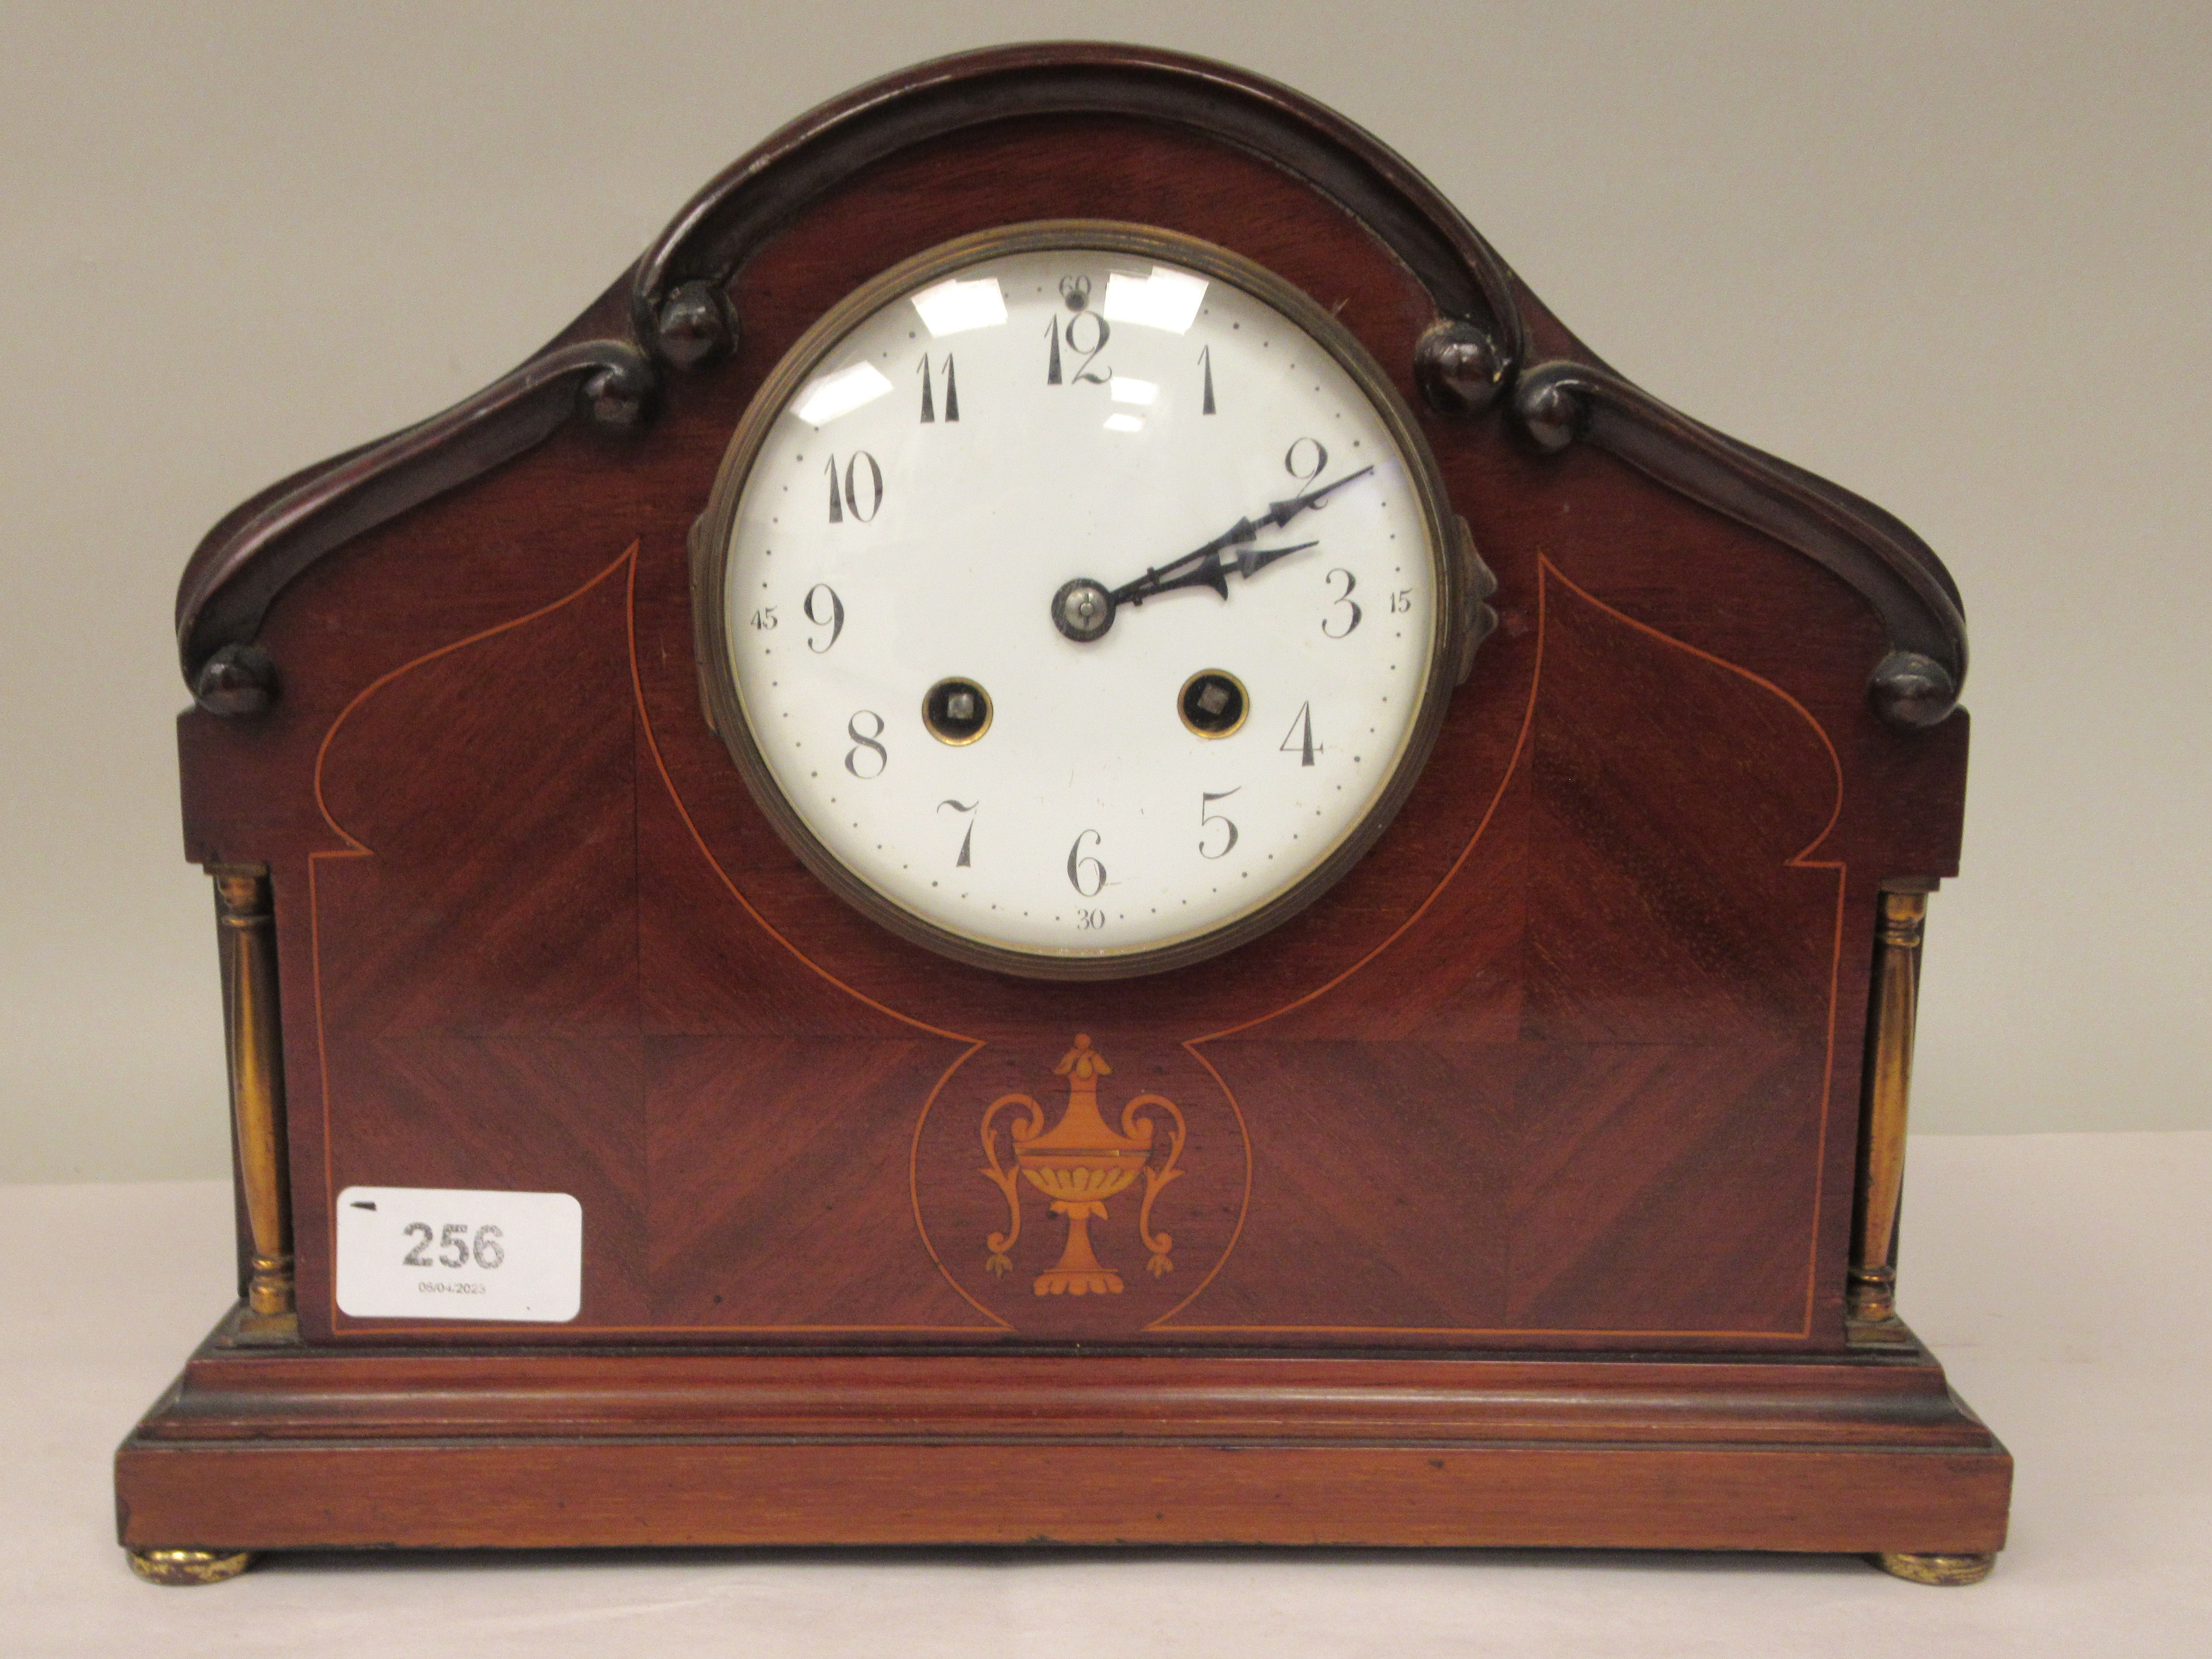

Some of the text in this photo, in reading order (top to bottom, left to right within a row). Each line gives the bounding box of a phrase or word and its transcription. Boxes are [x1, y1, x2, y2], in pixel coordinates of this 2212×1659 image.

[1059, 273, 1091, 298] 60
[1044, 311, 1112, 385] 12
[1198, 344, 1216, 416] 1
[917, 352, 960, 423] 11
[824, 451, 883, 524] 10
[1285, 437, 1329, 510] 2
[750, 605, 778, 630] 45
[803, 583, 845, 653] 9
[1321, 568, 1362, 639] 3
[1390, 587, 1413, 614] 15
[844, 710, 888, 778] 8
[1280, 701, 1324, 767] 4
[937, 799, 979, 867] 7
[1198, 786, 1241, 860] 5
[1067, 828, 1107, 897] 6
[1077, 908, 1106, 931] 30
[402, 1222, 504, 1269] 256
